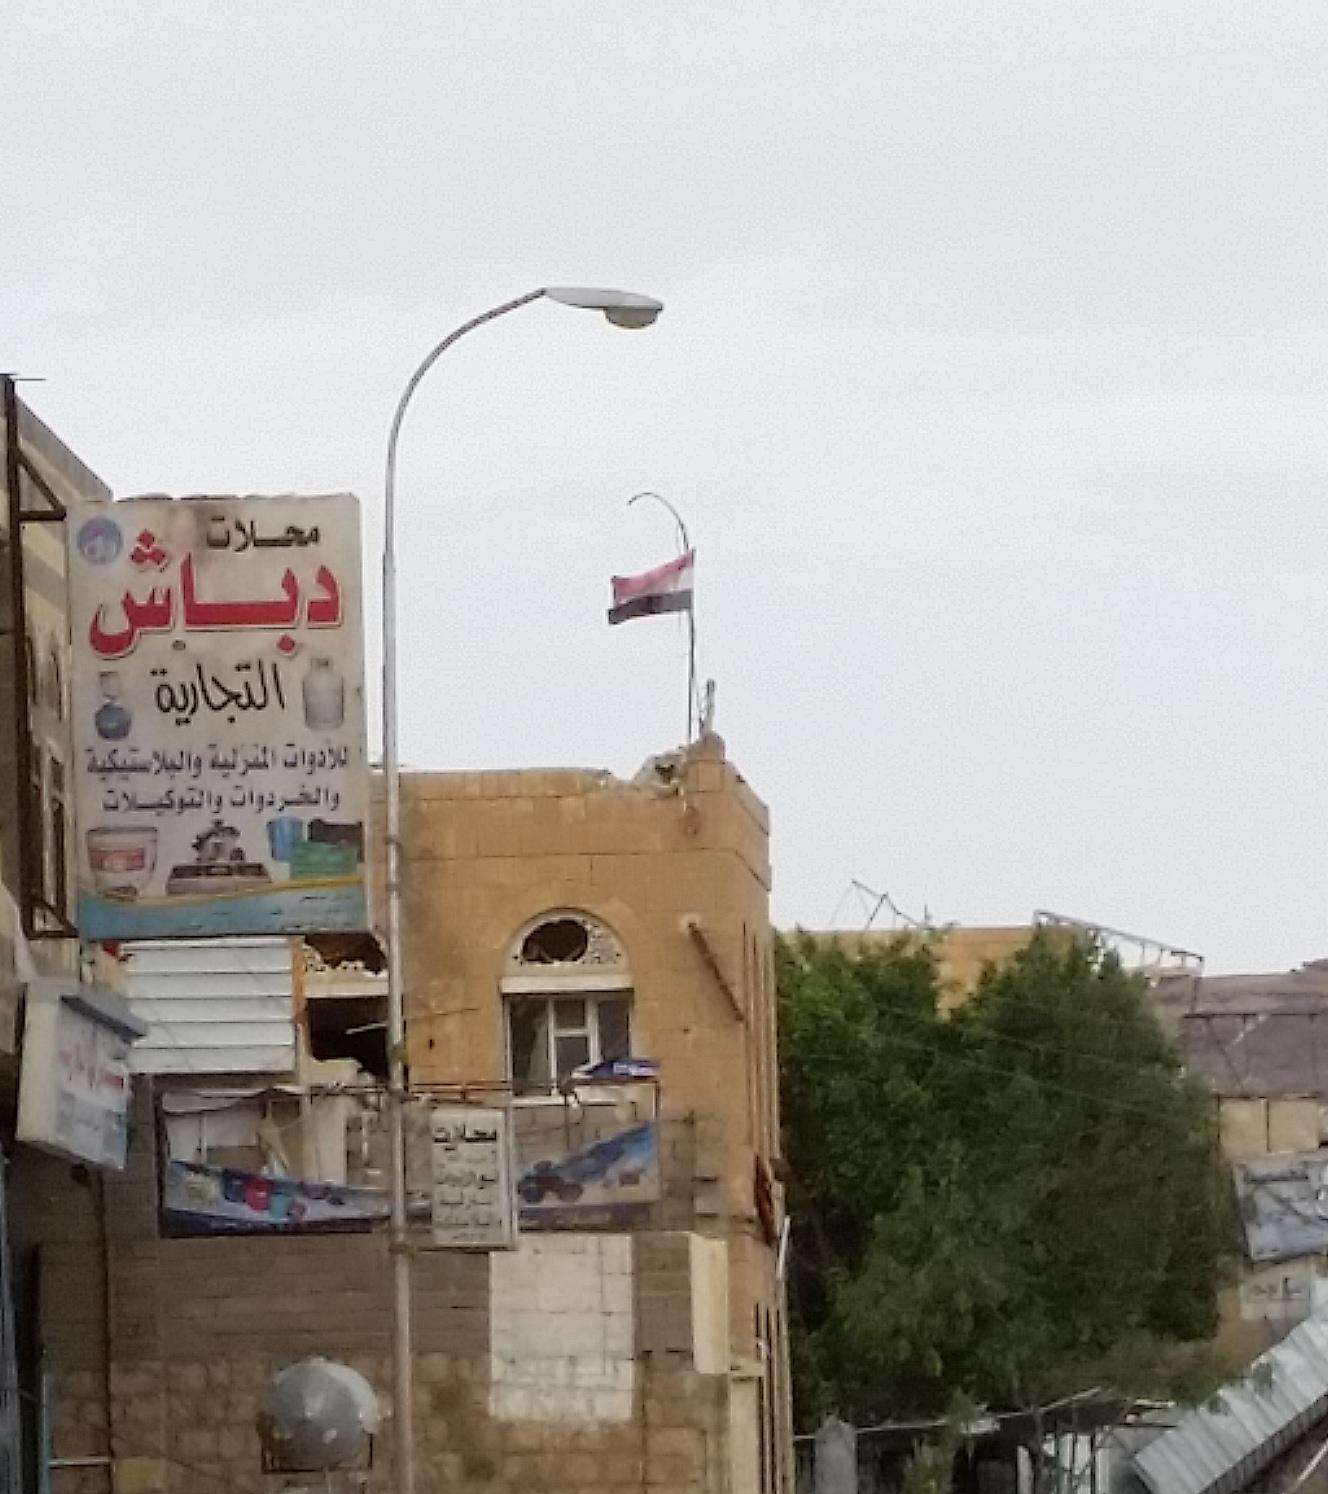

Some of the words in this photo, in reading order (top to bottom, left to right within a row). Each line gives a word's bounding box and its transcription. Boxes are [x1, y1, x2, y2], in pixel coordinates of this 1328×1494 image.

[206, 516, 320, 552] محلات
[90, 528, 343, 657] دباش
[150, 658, 286, 725] التجارية
